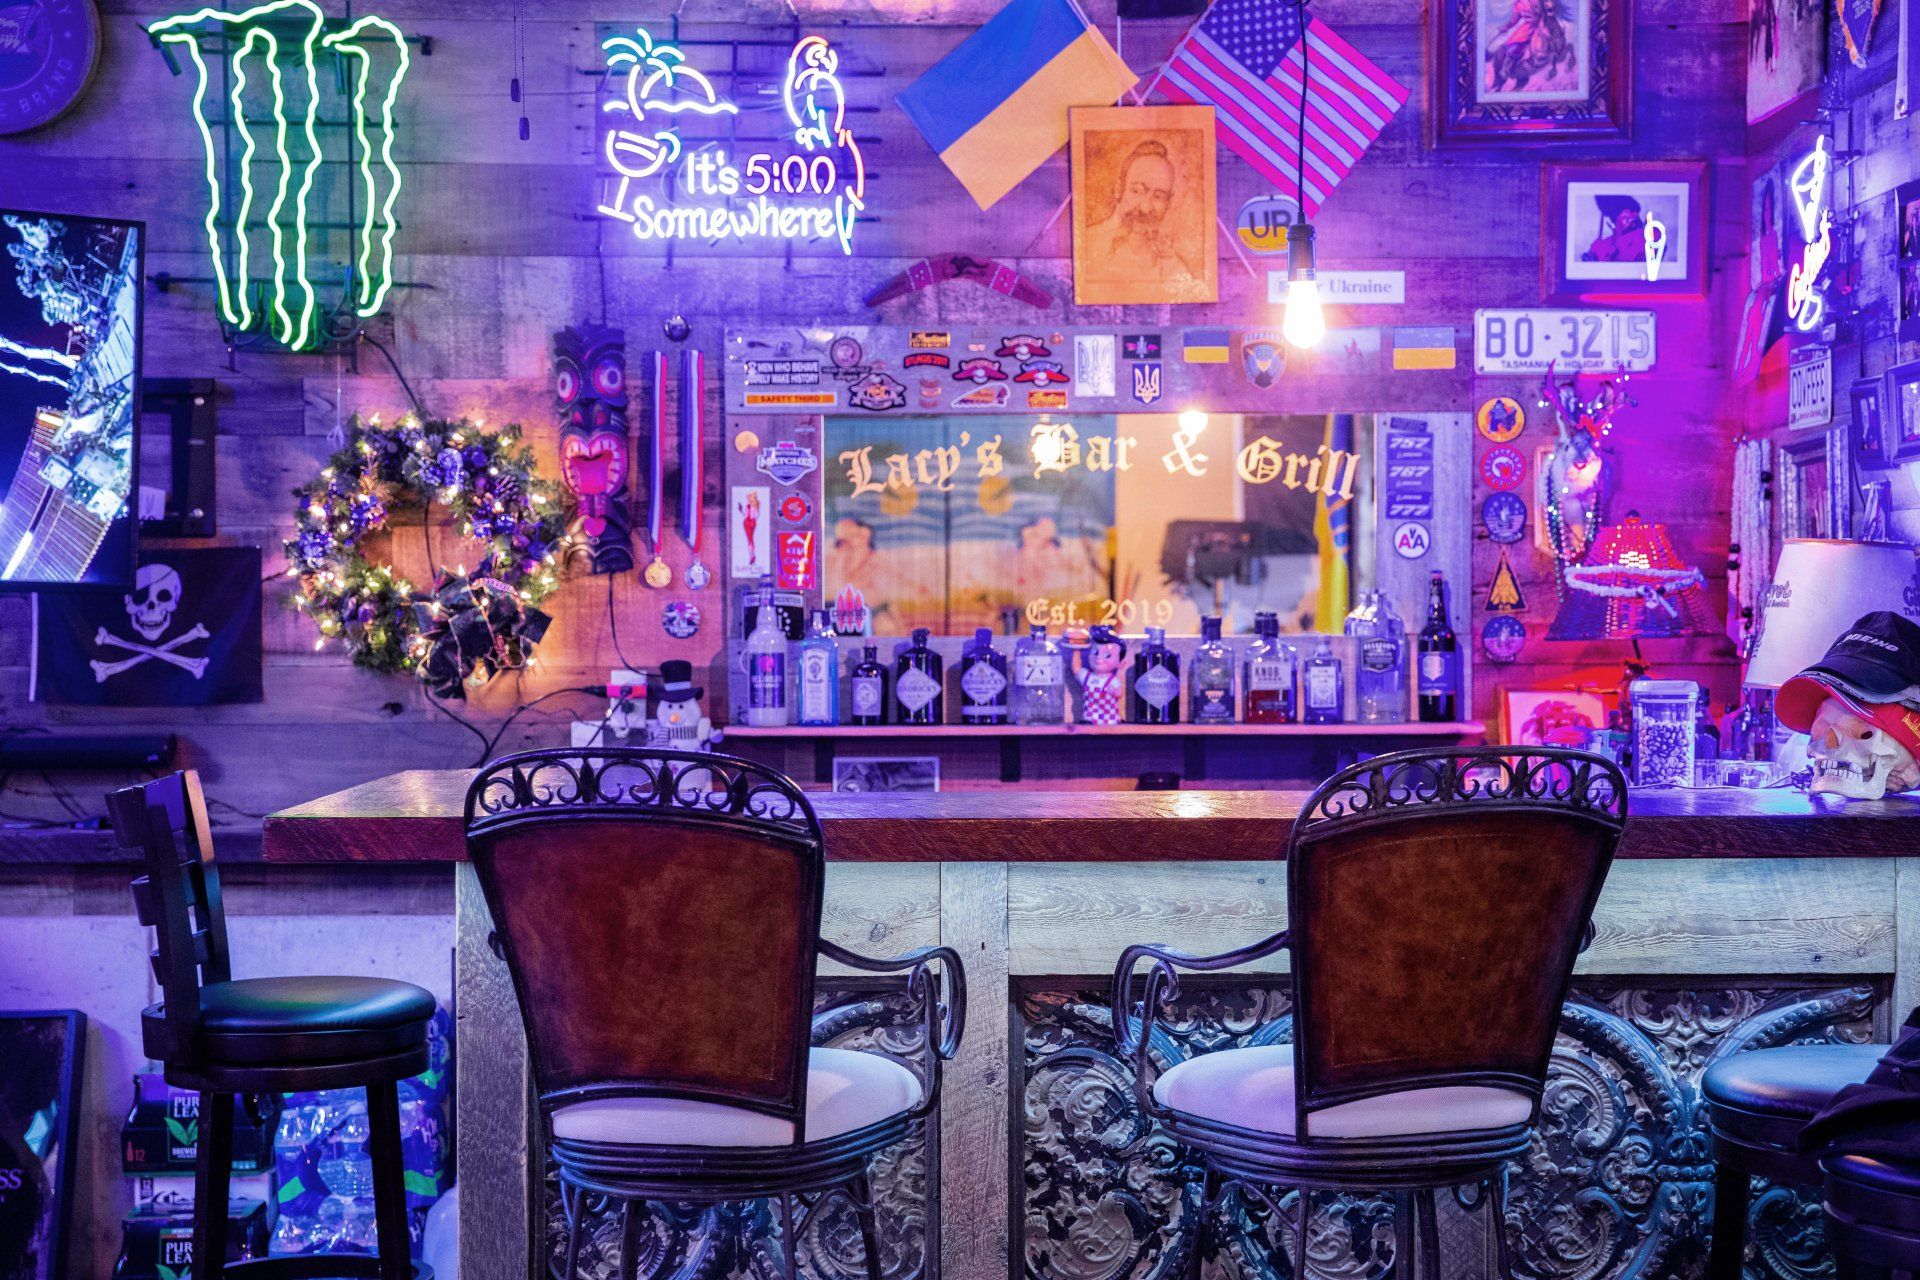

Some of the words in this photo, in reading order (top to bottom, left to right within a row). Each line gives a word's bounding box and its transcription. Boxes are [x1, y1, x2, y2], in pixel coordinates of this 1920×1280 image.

[687, 150, 739, 195] It's
[746, 153, 836, 194] 5:00
[633, 195, 837, 239] Somewhere
[1329, 278, 1392, 294] Ukraine
[1564, 359, 1605, 369] HOLIDAY
[1389, 436, 1431, 449] 757
[838, 430, 1004, 499] Lacy's
[1029, 422, 1139, 480] Bar
[1161, 430, 1209, 477] &
[1236, 435, 1361, 500] Grill
[1389, 503, 1430, 516] 777
[1025, 598, 1086, 626] Est.
[1100, 598, 1174, 627] 2019
[1254, 666, 1279, 678] KNOB
[174, 1096, 200, 1107] PUR
[173, 1107, 200, 1118] LEA
[135, 1148, 146, 1162] 12
[171, 1147, 197, 1156] BREWE
[165, 1242, 193, 1253] PUR
[165, 1253, 193, 1265] LEA
